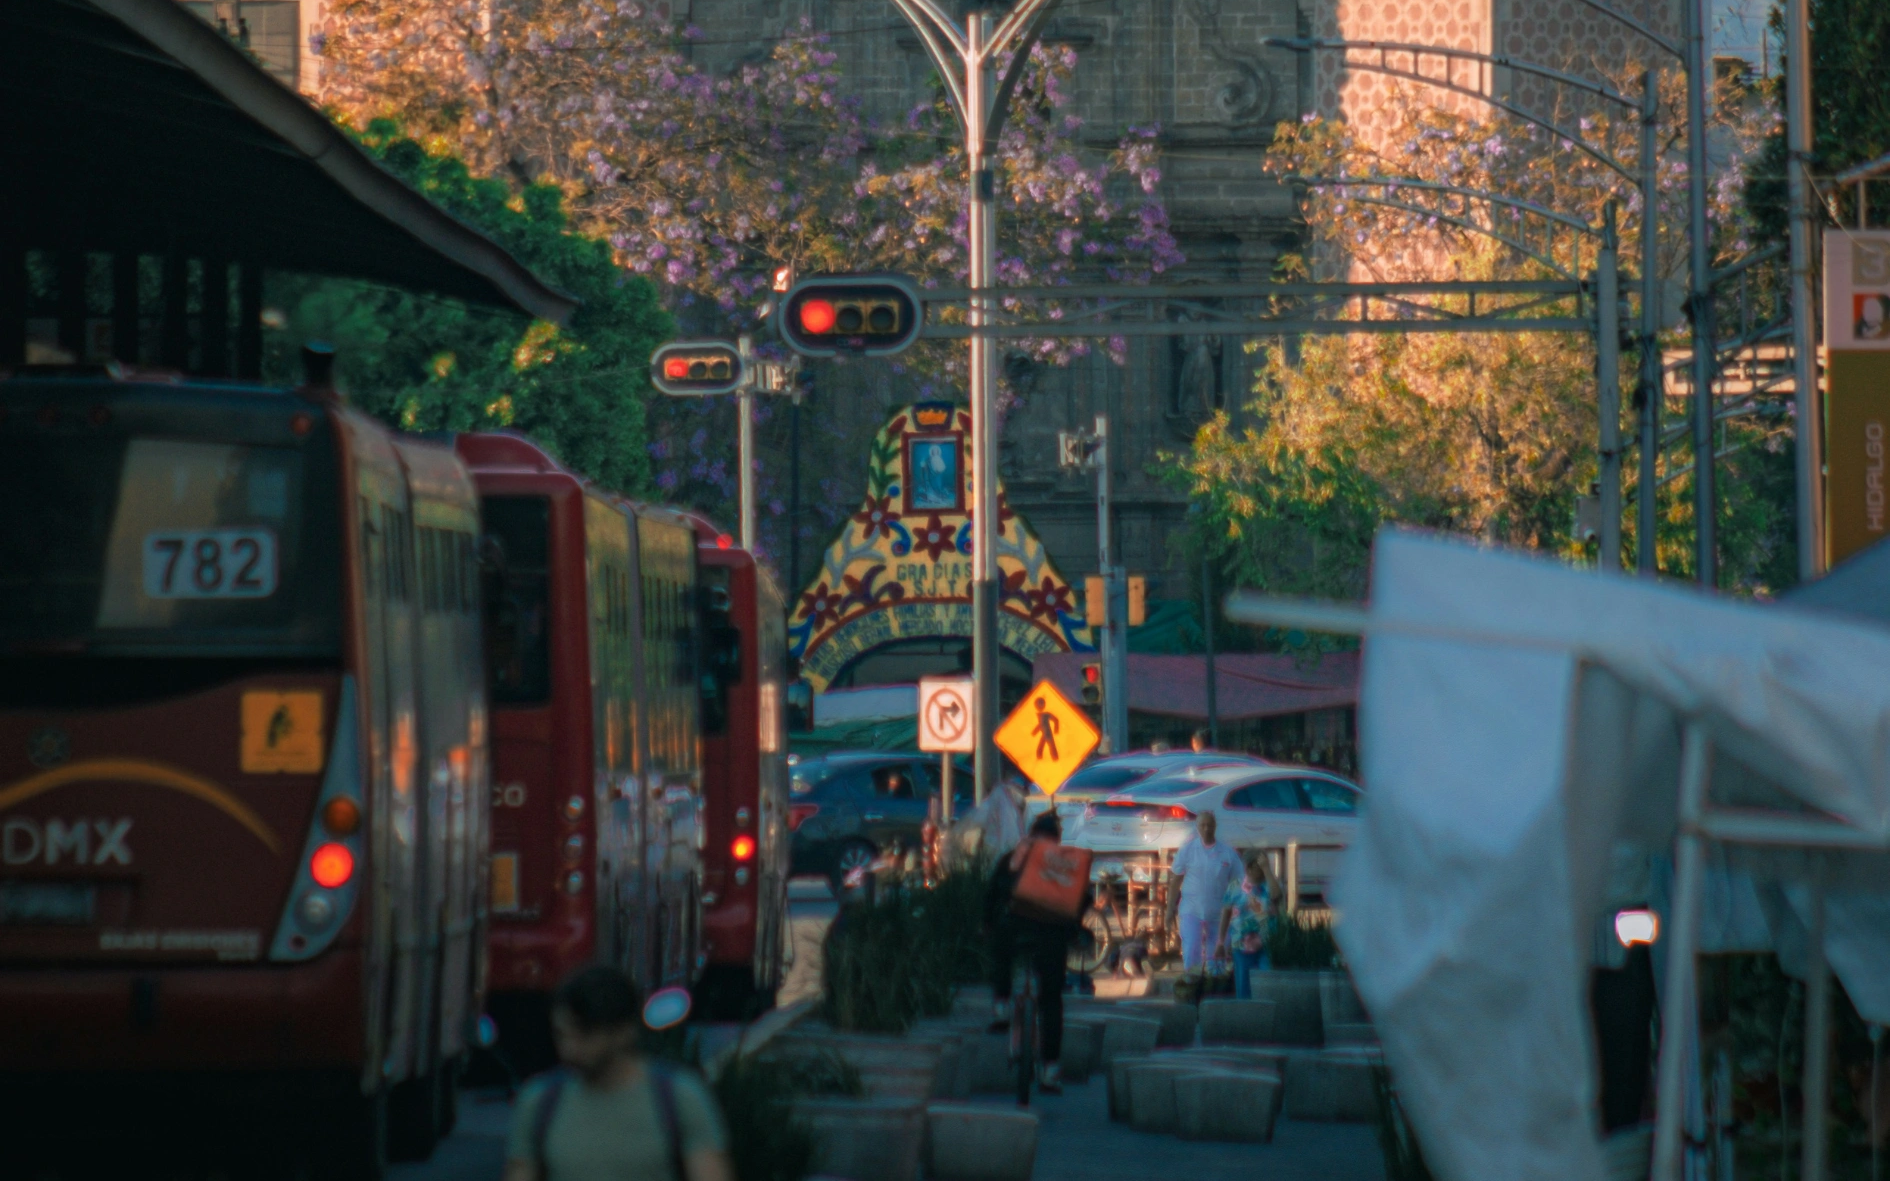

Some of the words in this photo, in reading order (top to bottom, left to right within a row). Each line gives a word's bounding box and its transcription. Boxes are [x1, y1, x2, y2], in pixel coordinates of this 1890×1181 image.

[1864, 422, 1885, 532] HIDALGO
[154, 537, 262, 590] 782
[897, 562, 972, 581] GRACIAS
[2, 820, 135, 864] DMX
